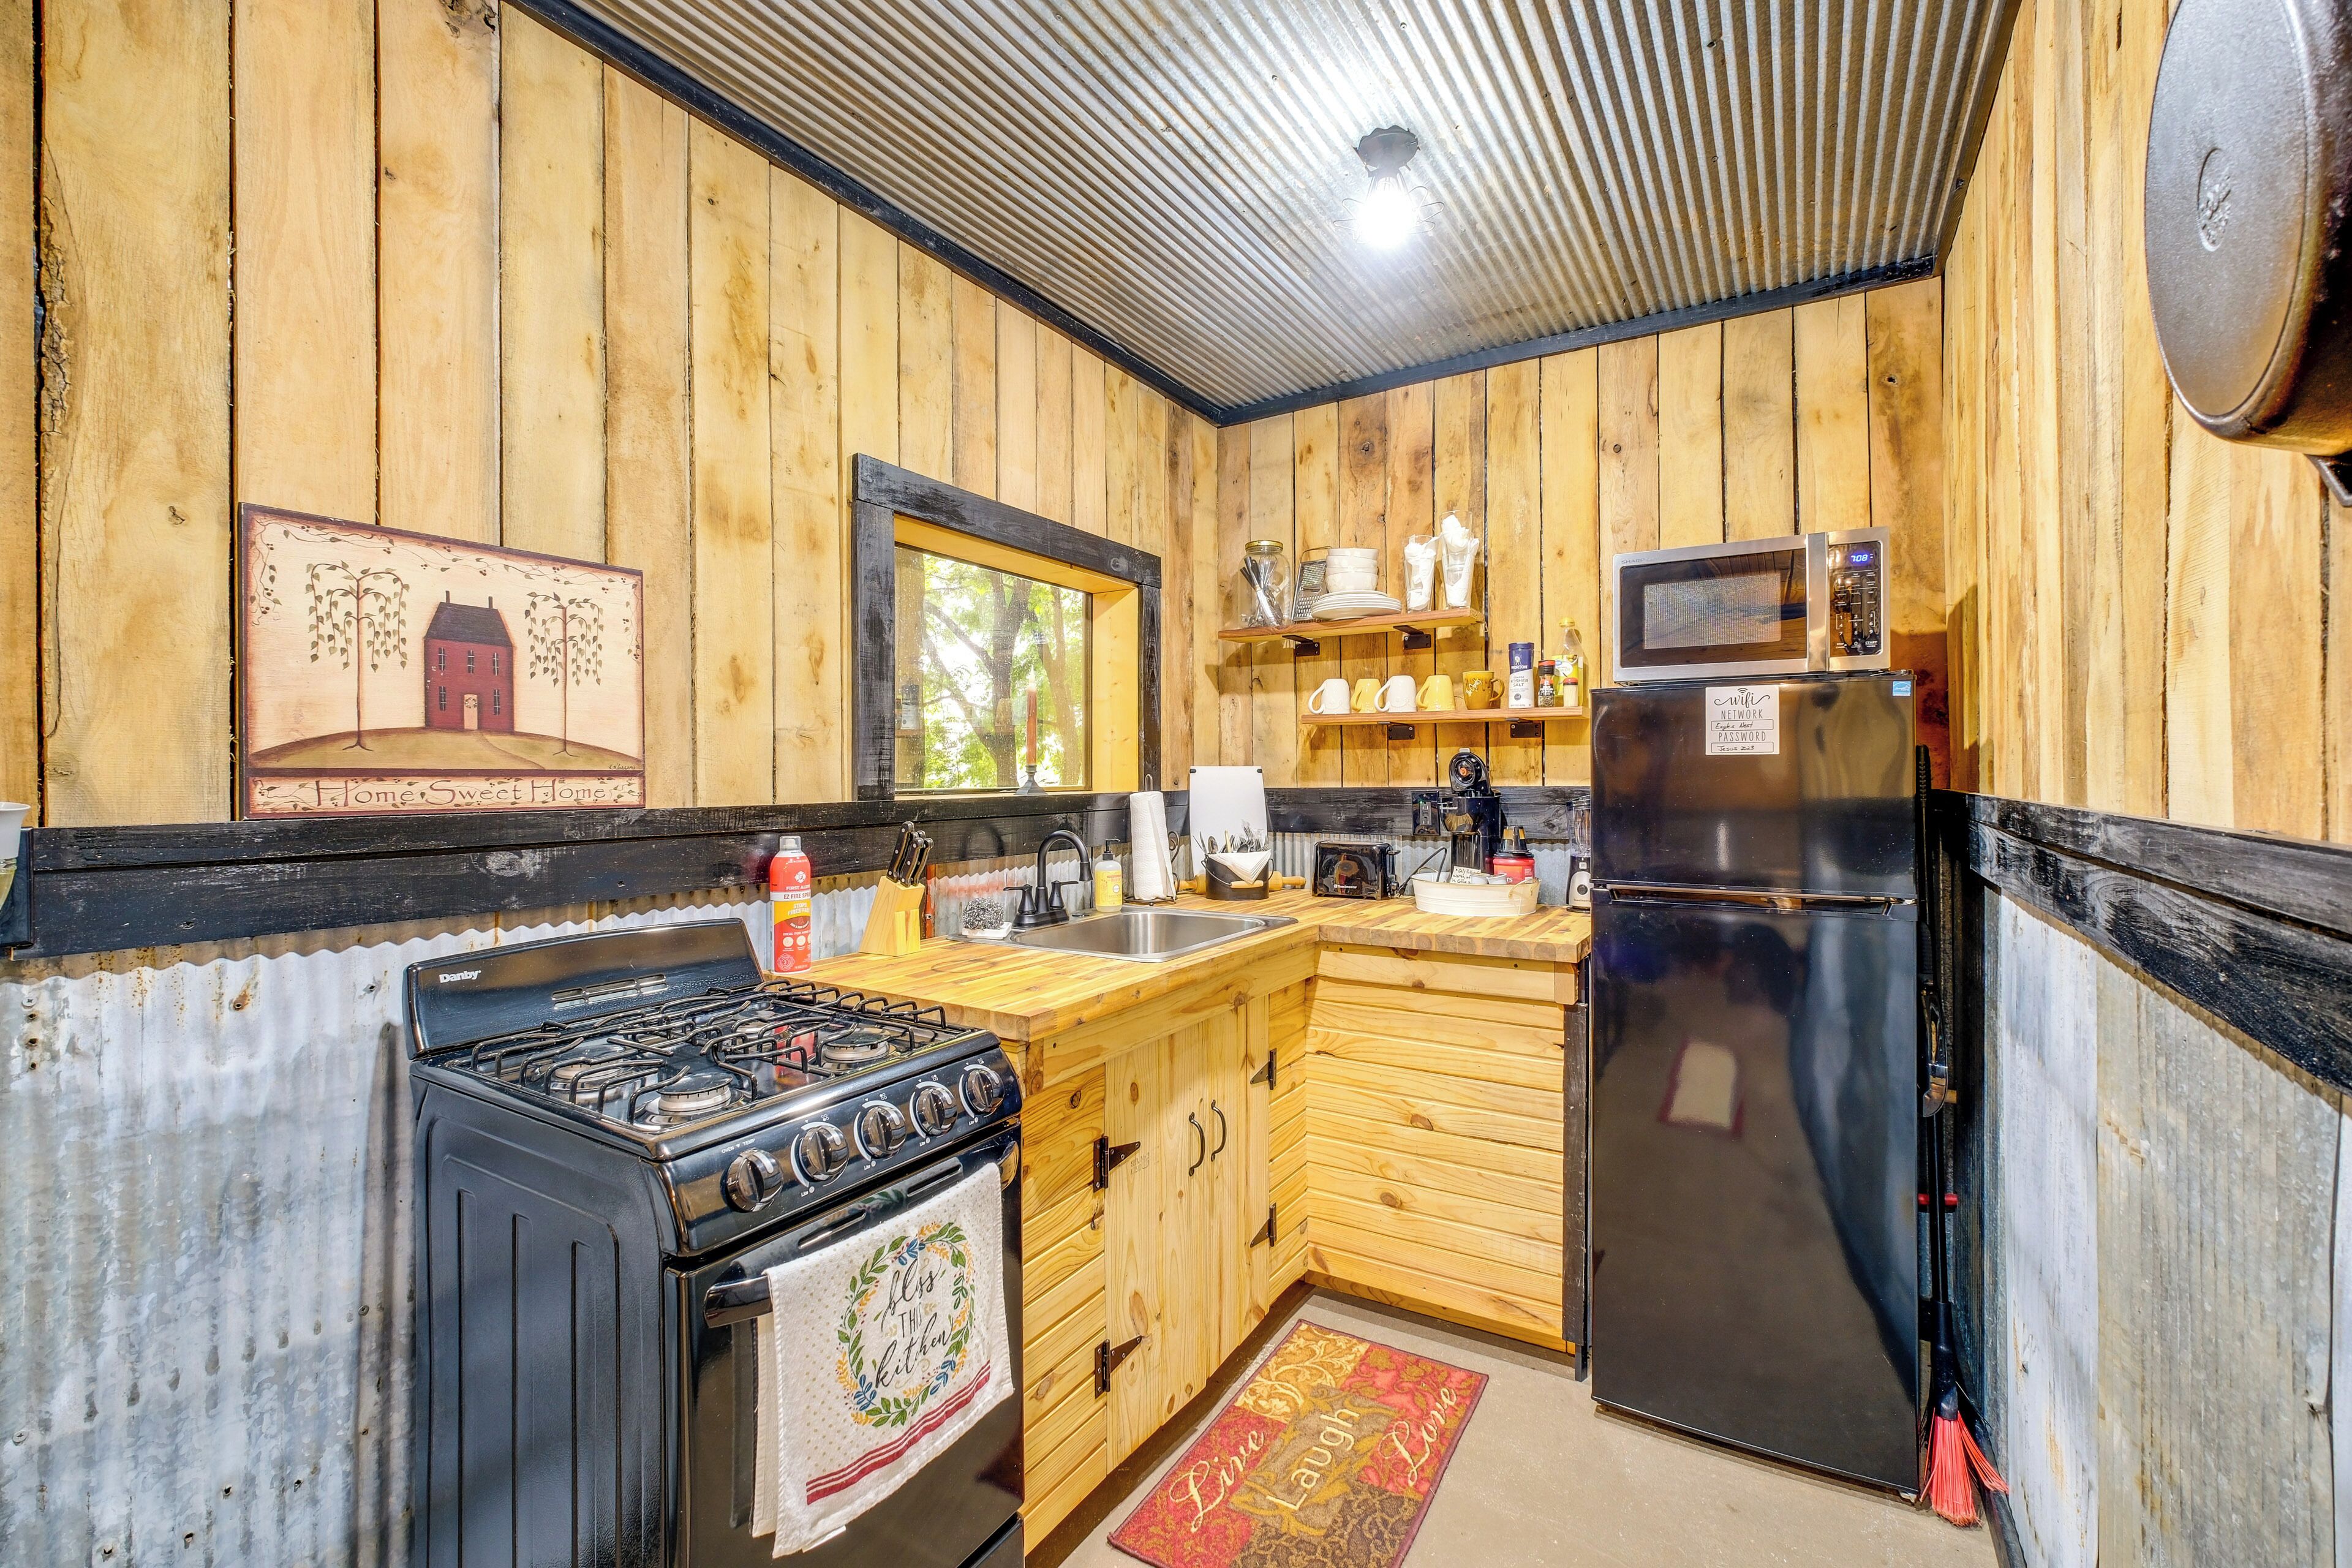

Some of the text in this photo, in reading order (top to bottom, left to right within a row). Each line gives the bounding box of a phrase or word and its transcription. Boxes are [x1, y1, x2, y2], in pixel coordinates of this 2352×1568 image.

[1714, 692, 1770, 709] wifi
[1721, 709, 1763, 720] NETWORK
[1715, 722, 1735, 731] Eagles
[1718, 731, 1766, 742] PASSWORD
[315, 778, 606, 807] Home Sweet Home
[439, 970, 479, 984] Danby
[898, 1302, 922, 1338] THIS
[875, 1312, 954, 1389] kitchen
[1379, 1387, 1458, 1487] Love
[1265, 1408, 1361, 1512] Laugh
[1169, 1430, 1266, 1534] Live
